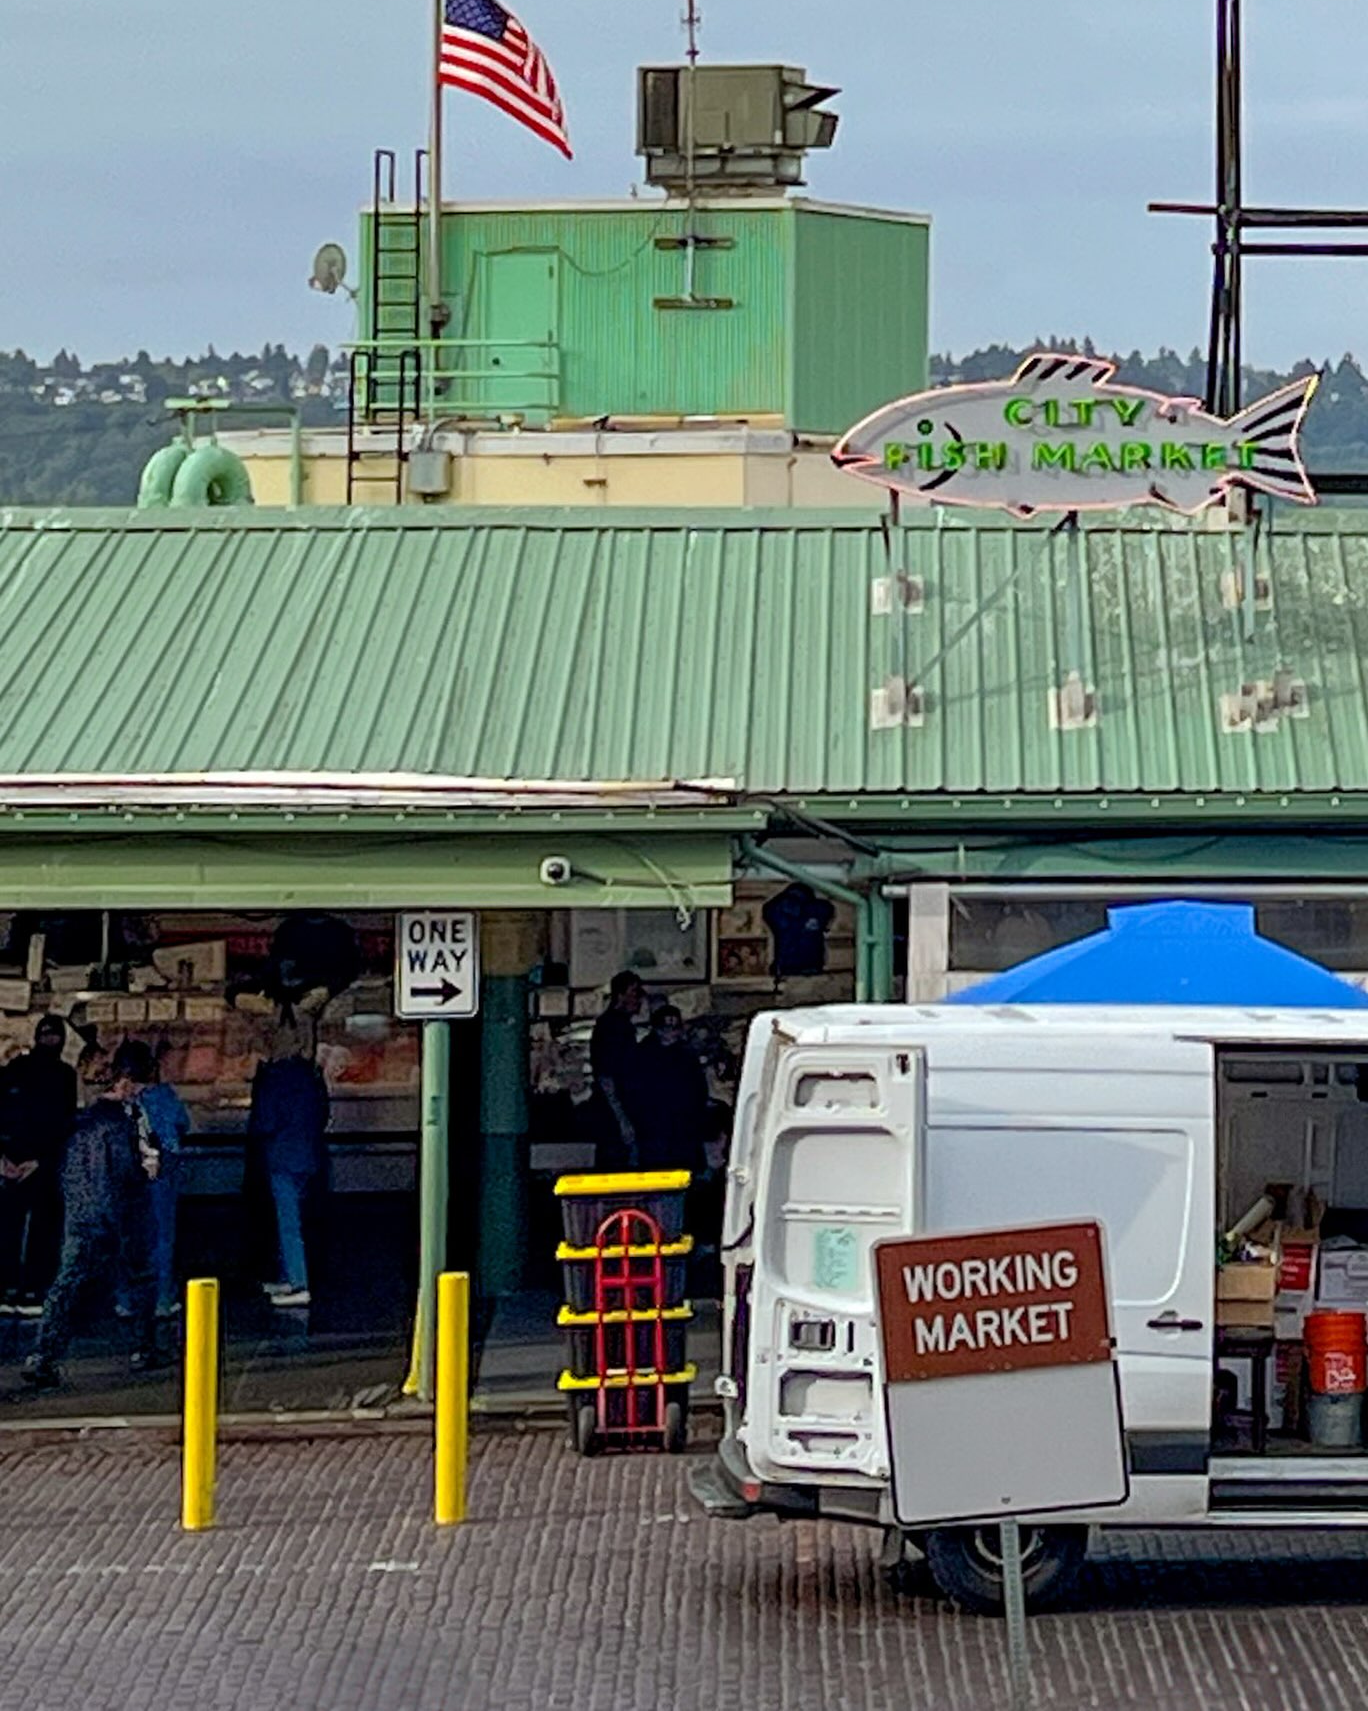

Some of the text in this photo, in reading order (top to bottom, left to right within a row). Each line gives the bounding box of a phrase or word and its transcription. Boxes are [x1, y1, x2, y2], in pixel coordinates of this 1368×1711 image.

[1003, 396, 1144, 427] CITY
[884, 440, 1259, 471] FISH MARKET
[408, 919, 467, 944] ONE
[407, 949, 469, 974] WAY
[902, 1250, 1078, 1304] WORKING
[914, 1301, 1074, 1356] MARKET
